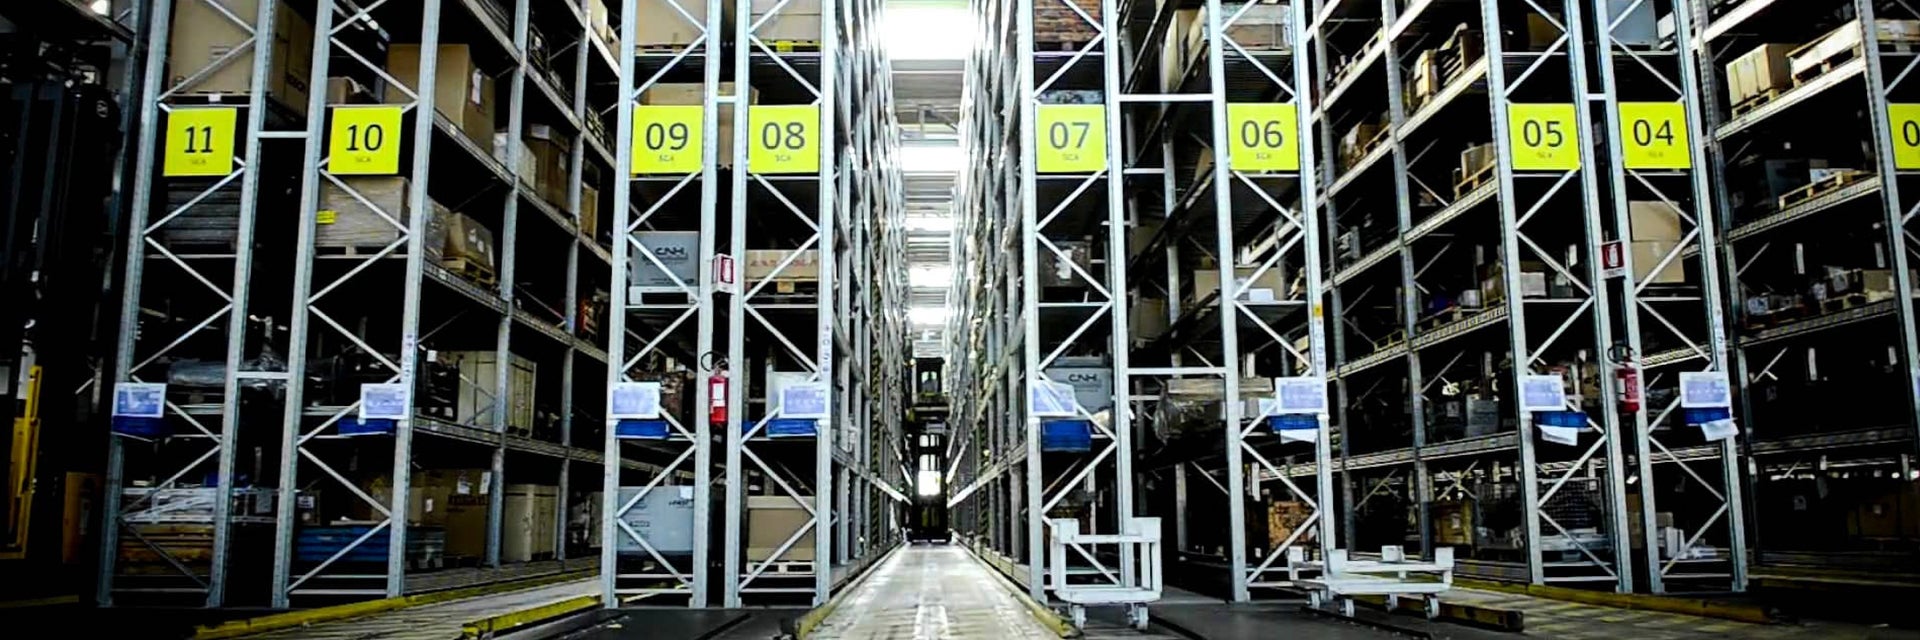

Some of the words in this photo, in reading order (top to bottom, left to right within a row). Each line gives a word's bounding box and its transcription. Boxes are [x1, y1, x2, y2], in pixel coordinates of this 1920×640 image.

[184, 126, 213, 153] 11
[345, 124, 384, 151] 10
[645, 122, 688, 150] 09
[762, 122, 805, 150] 08
[1049, 121, 1091, 149] 07
[1241, 120, 1283, 148] 06
[1523, 120, 1563, 147] 05
[1633, 119, 1674, 146] 04
[655, 247, 685, 255] CNH
[1068, 374, 1097, 382] CNH
